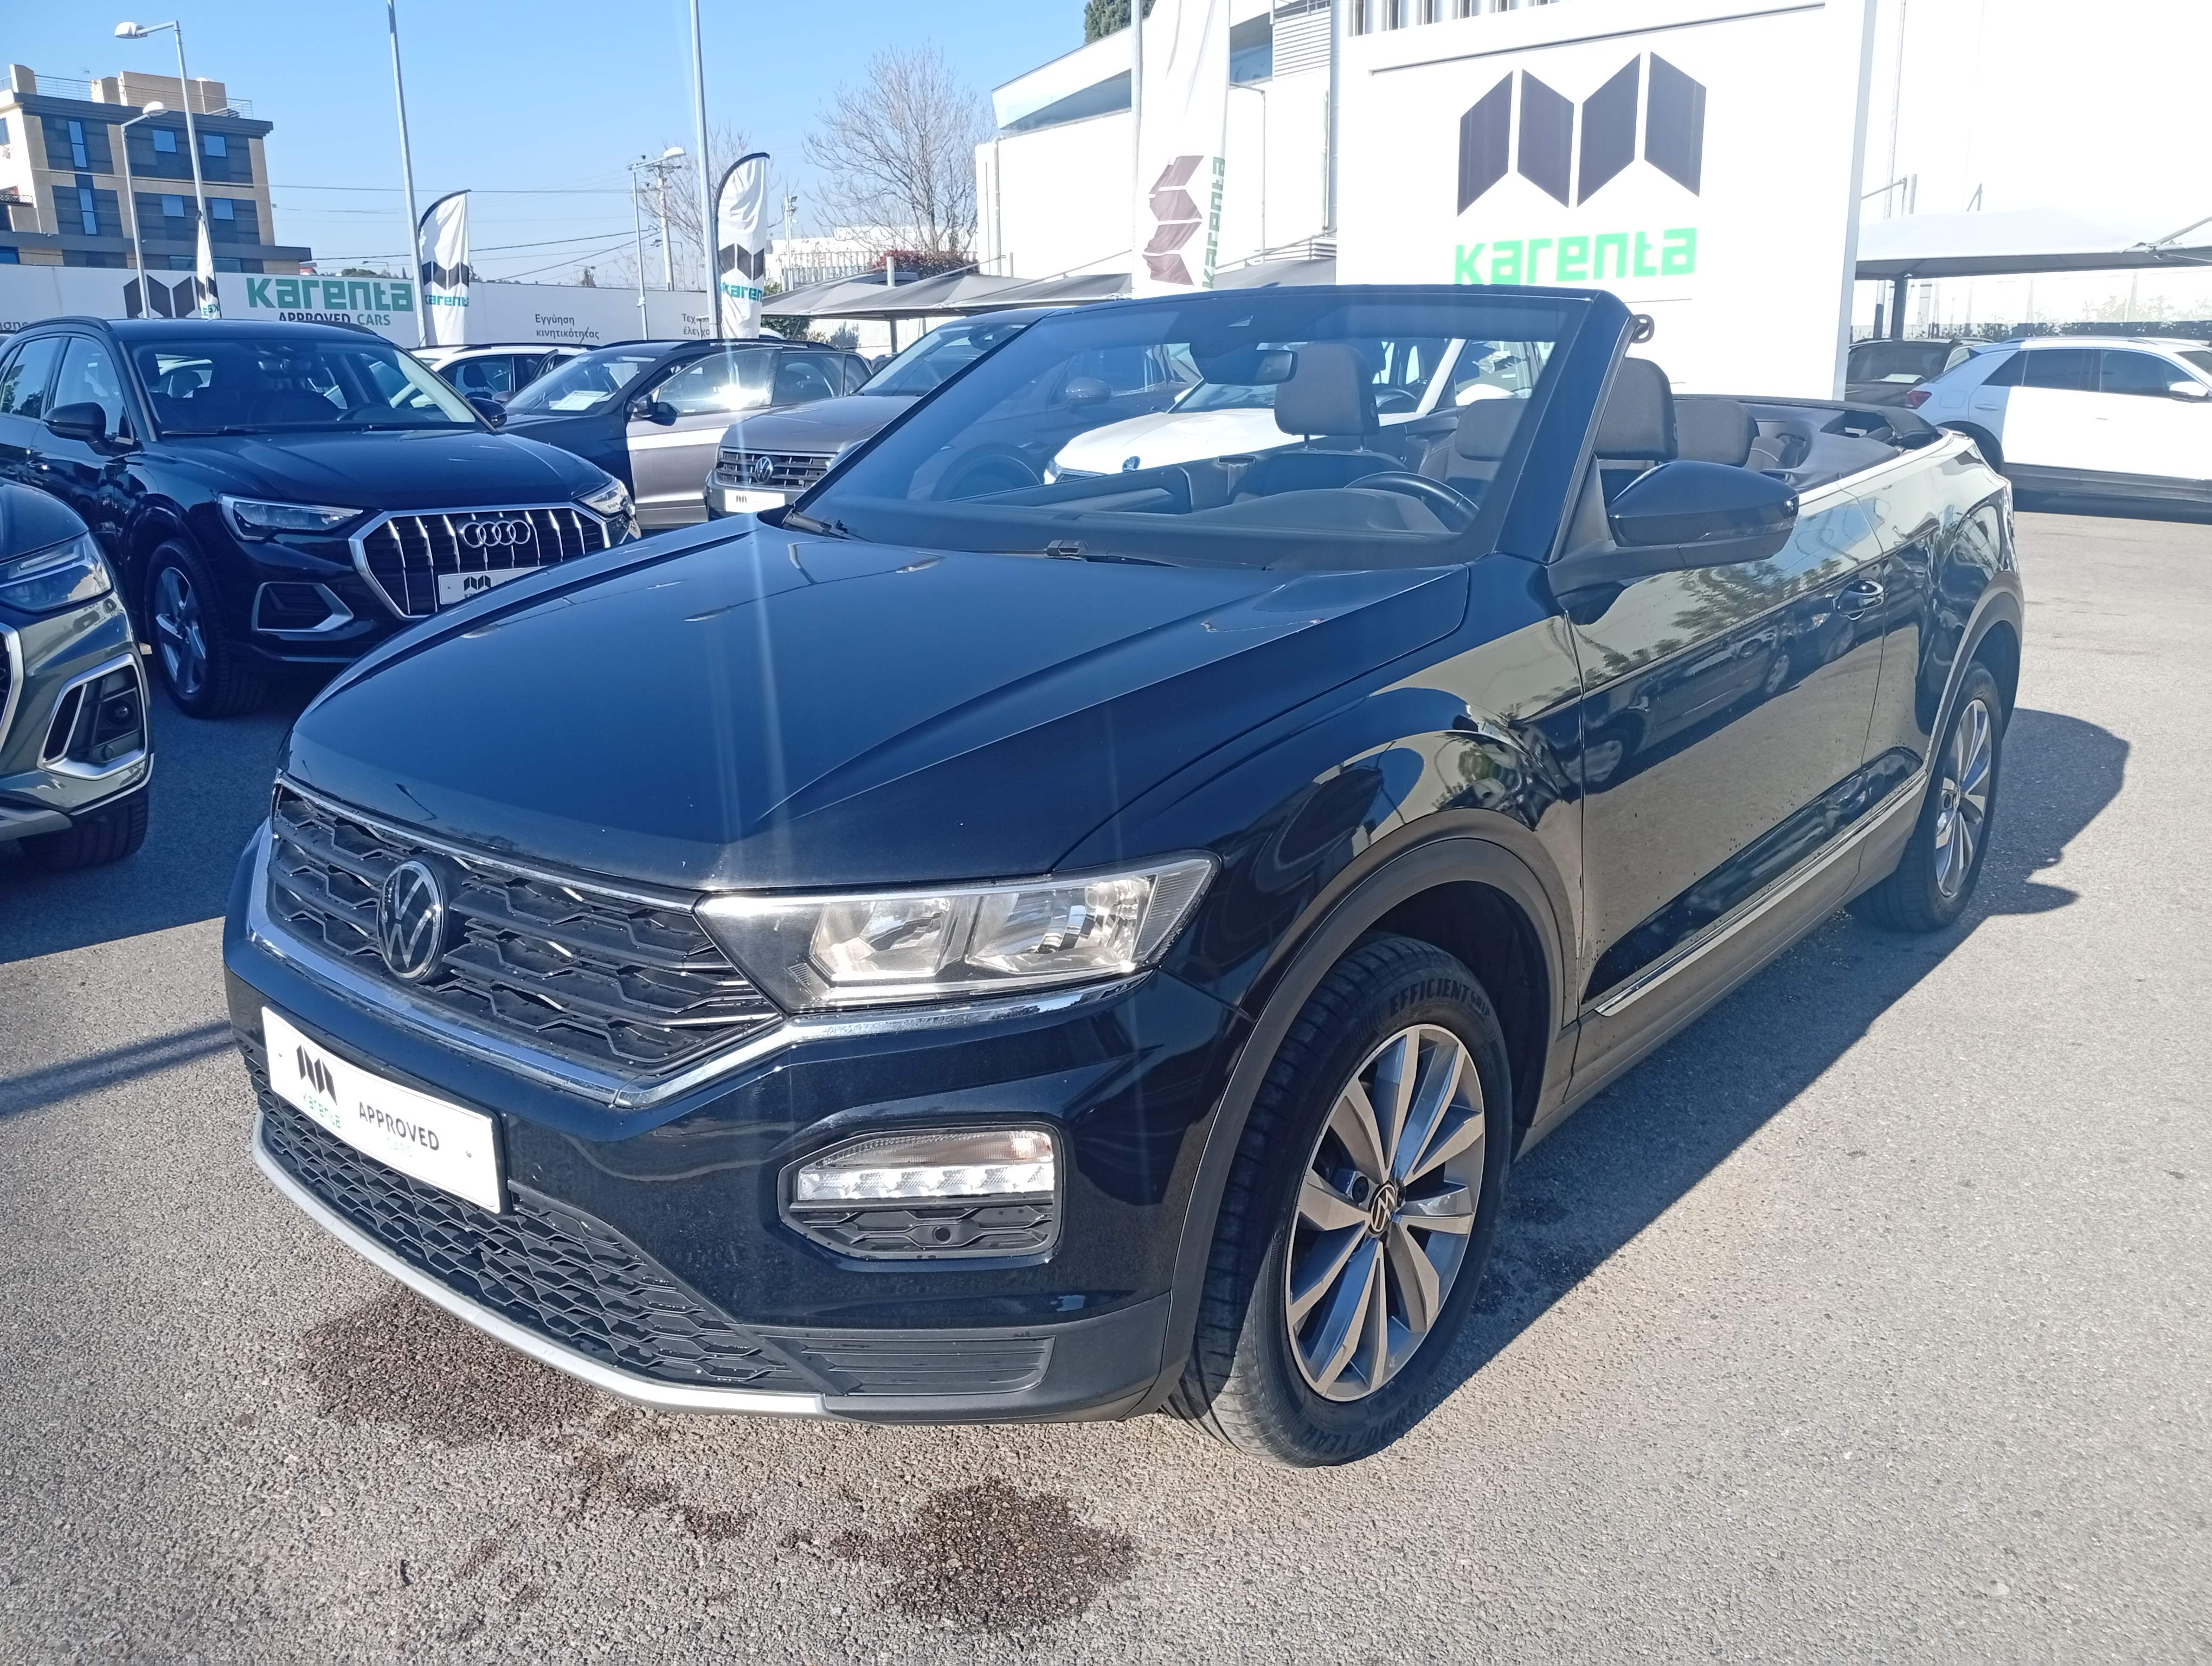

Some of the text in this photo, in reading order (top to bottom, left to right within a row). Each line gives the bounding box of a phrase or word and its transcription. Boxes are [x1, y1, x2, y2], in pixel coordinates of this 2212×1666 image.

[357, 313, 391, 326] CARS
[535, 313, 575, 326] Εγγύηση
[536, 328, 600, 340] κινητικότητας
[359, 1101, 439, 1151] APPROVED
